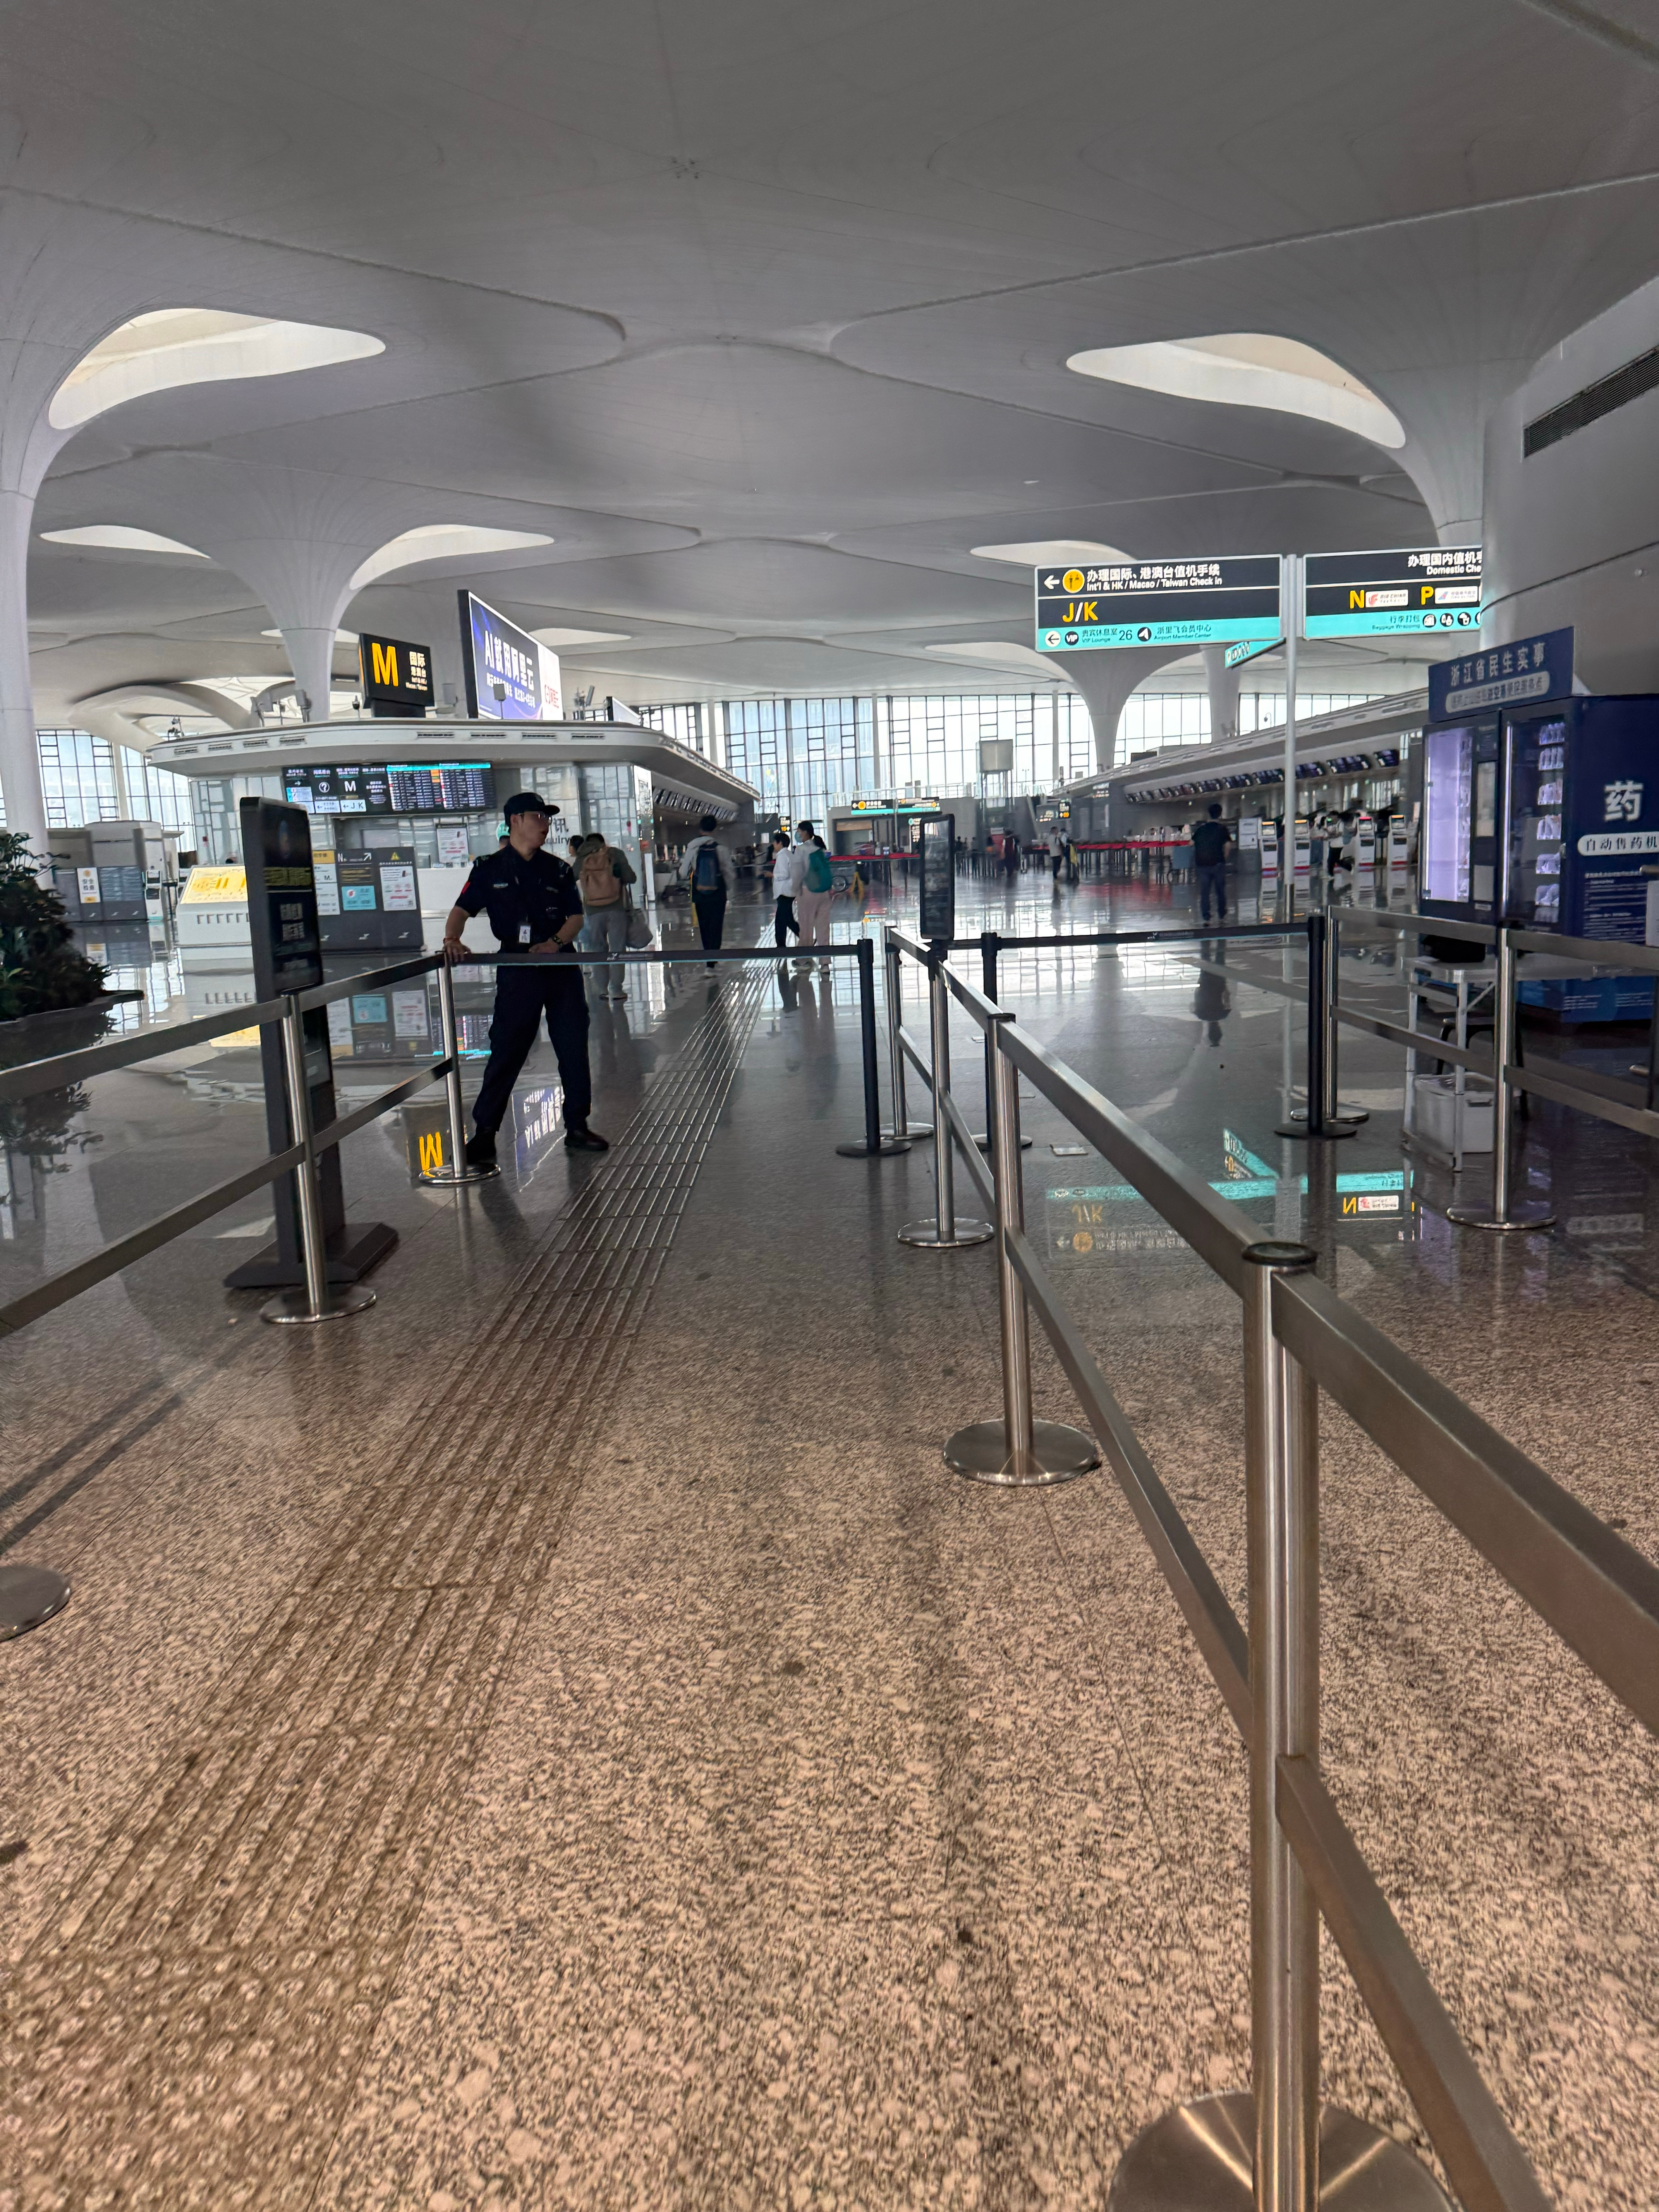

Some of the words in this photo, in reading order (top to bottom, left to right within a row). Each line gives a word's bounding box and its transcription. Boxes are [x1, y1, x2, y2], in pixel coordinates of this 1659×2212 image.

[1087, 563, 1220, 582] 办理国际、港澳台值机手续
[1427, 565, 1465, 575] Domestic
[1103, 582, 1110, 591] &
[1112, 581, 1123, 590] HK
[1129, 580, 1154, 589] Macao
[1161, 579, 1188, 587] Taiwan
[1190, 577, 1213, 586] Check
[1350, 590, 1365, 609] N
[1421, 586, 1434, 605] P
[1119, 630, 1133, 641] 26
[372, 642, 398, 687] M
[344, 781, 356, 792] M
[1604, 780, 1644, 823] 药
[553, 817, 569, 833] 讯
[1587, 835, 1657, 852] 自动售药机
